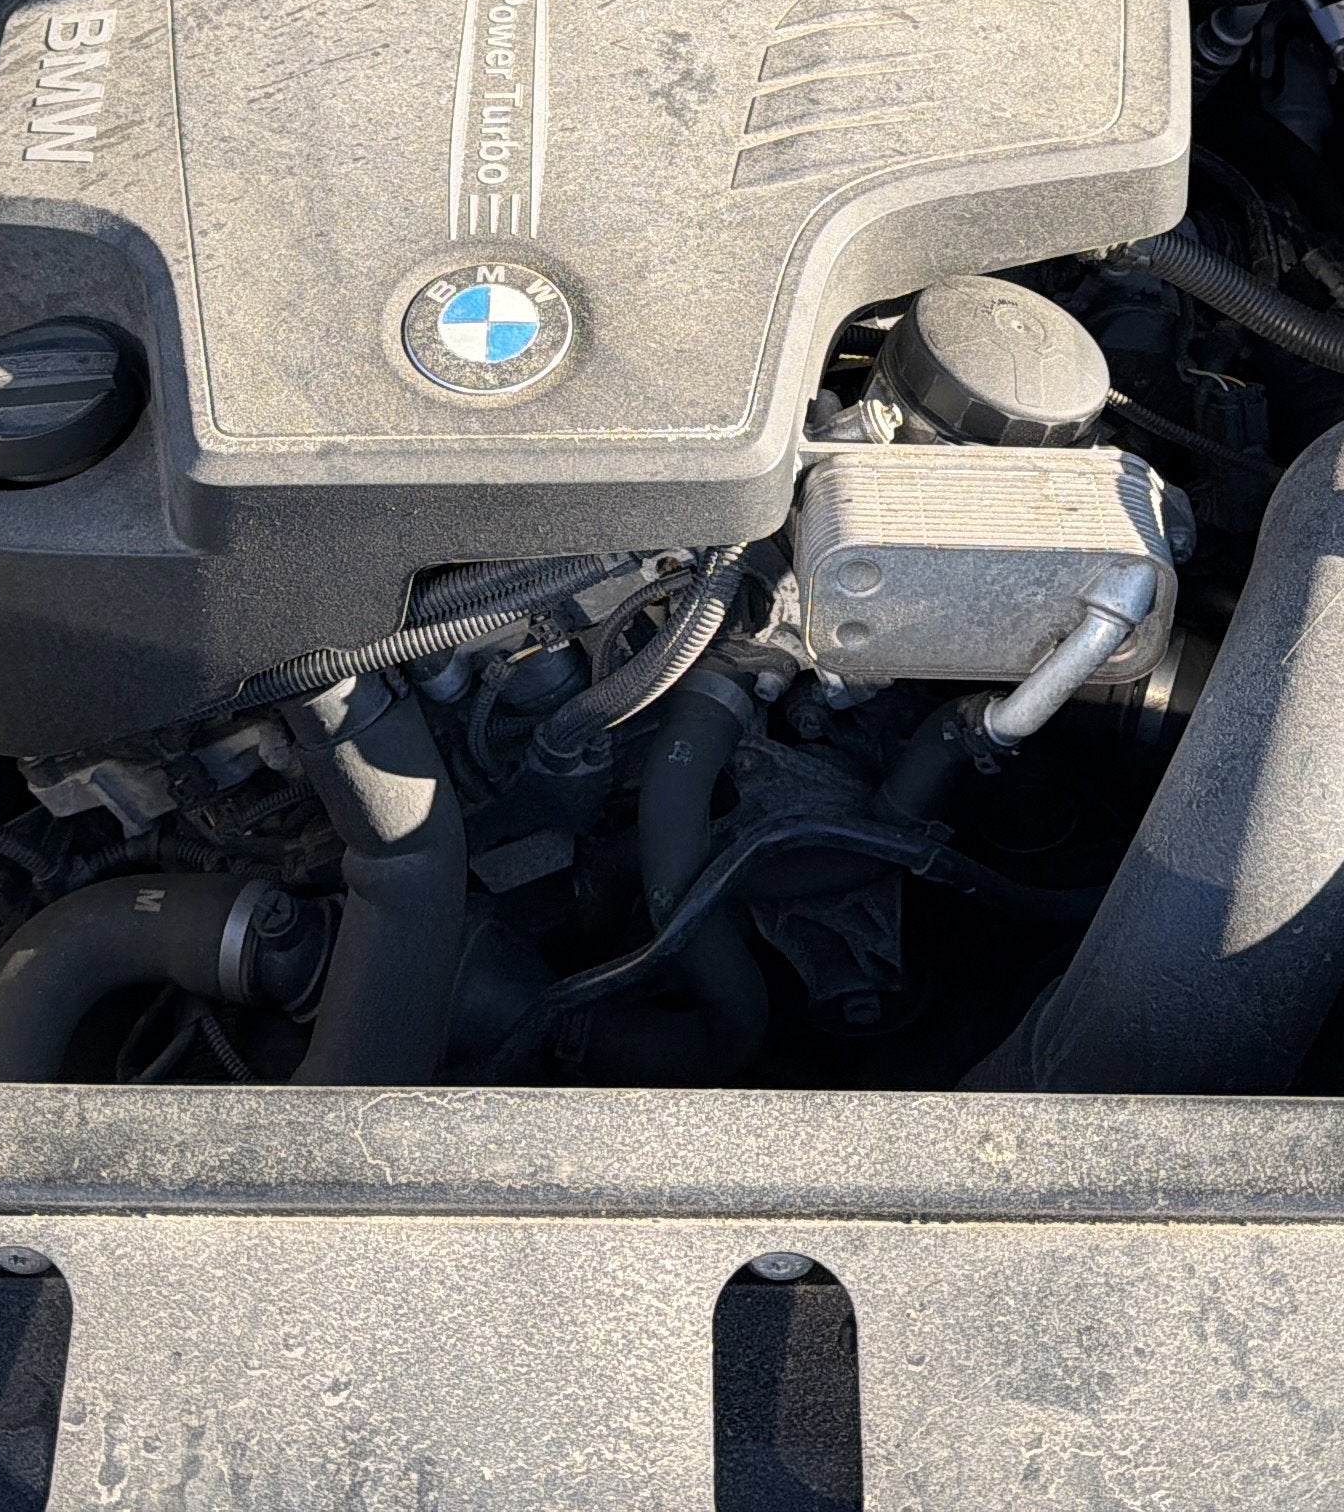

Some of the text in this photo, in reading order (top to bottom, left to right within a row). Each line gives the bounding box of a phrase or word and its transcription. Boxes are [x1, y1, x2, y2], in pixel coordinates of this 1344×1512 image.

[22, 8, 118, 164] BMW
[476, 83, 525, 185] Turbo
[425, 265, 558, 305] BMW
